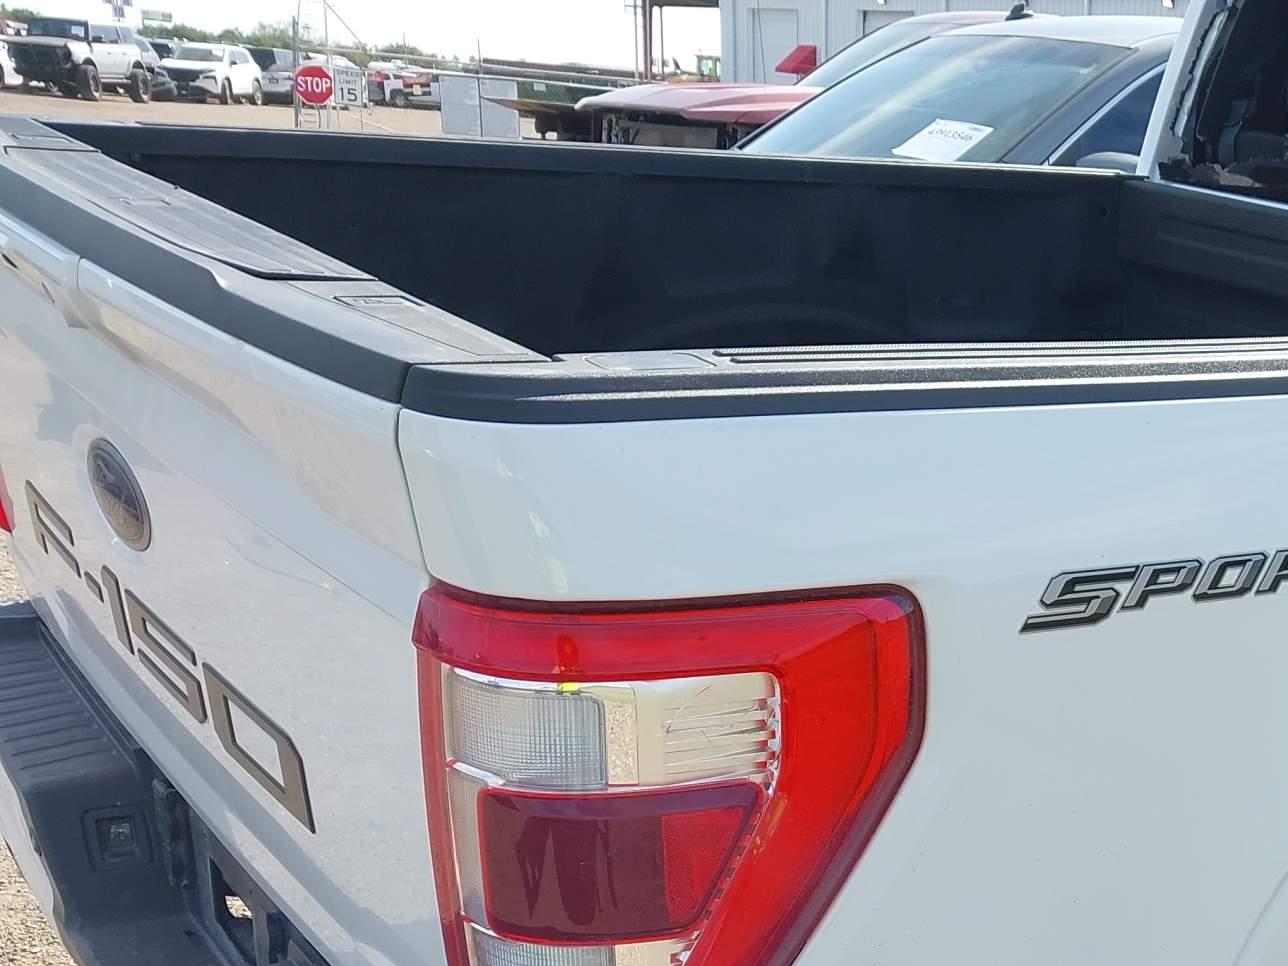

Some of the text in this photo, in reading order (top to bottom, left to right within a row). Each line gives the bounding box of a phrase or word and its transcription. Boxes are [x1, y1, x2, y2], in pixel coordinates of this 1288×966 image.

[297, 76, 331, 93] STOP
[339, 87, 358, 102] 15
[25, 480, 316, 834] F-150
